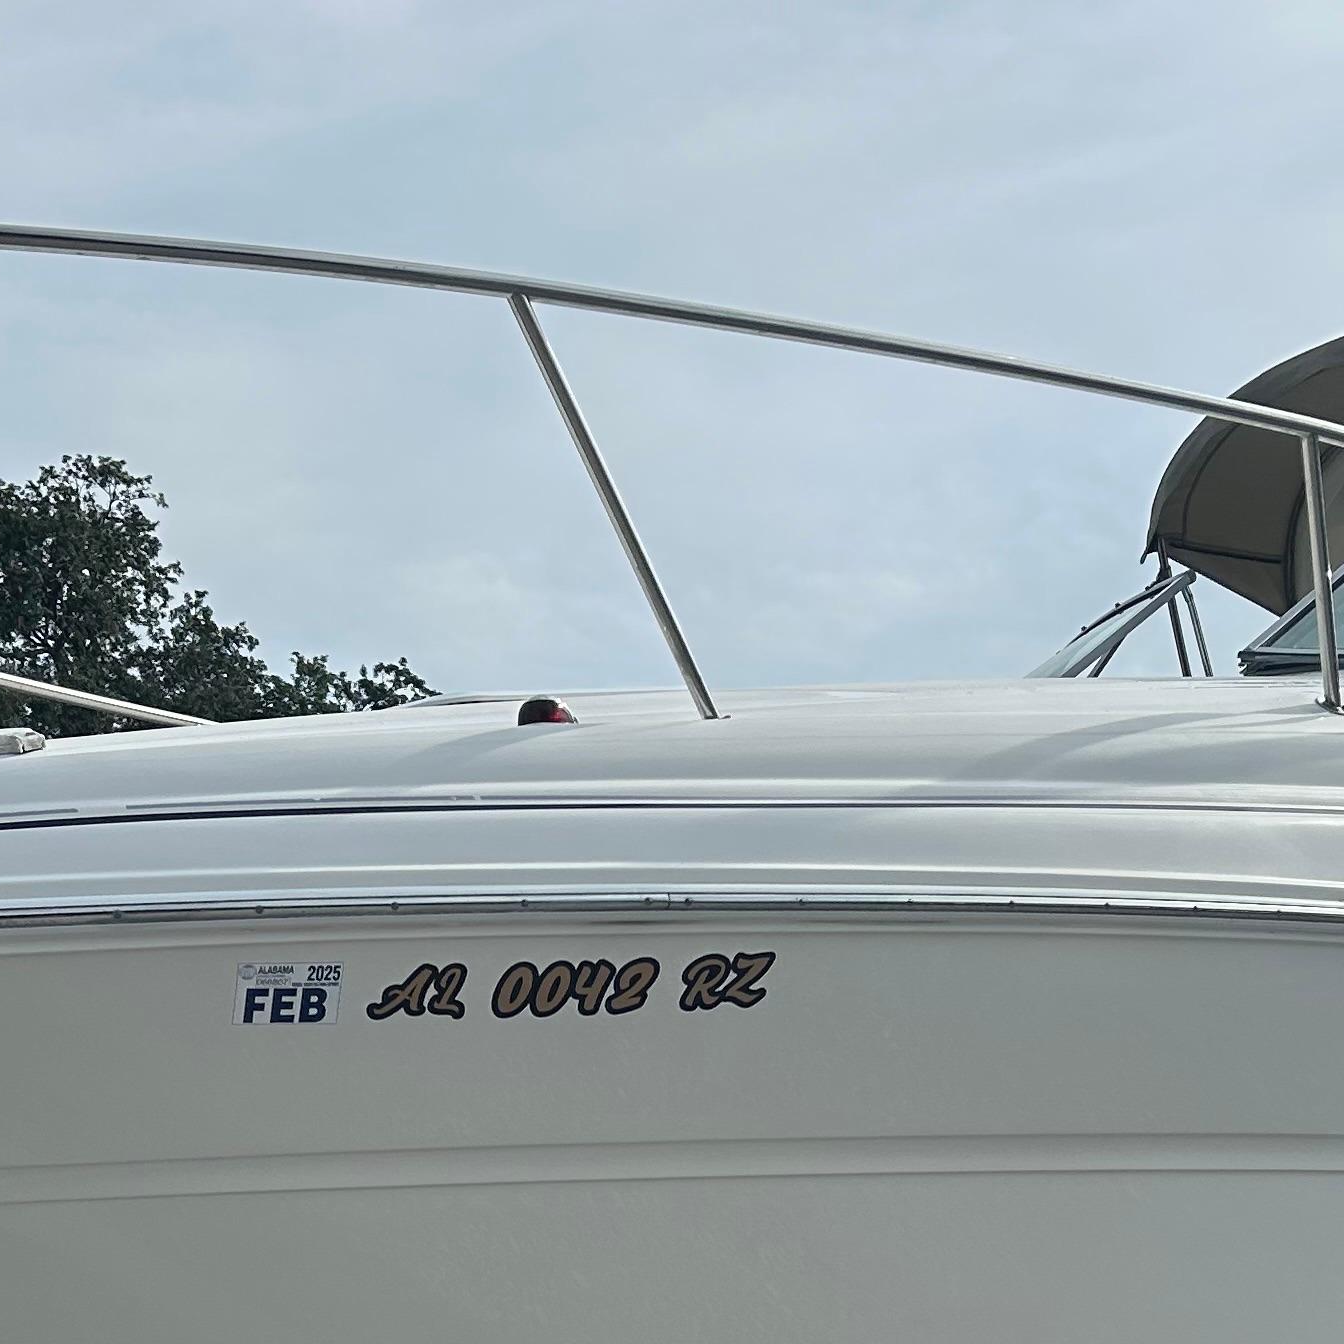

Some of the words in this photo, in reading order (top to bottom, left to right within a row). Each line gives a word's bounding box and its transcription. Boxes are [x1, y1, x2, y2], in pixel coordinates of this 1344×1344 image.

[258, 965, 294, 975] ALABAMA
[307, 965, 342, 981] 2025
[366, 963, 468, 1020] AL
[491, 957, 661, 1019] 0042
[679, 952, 776, 1012] RZ
[243, 988, 327, 1023] FEB
